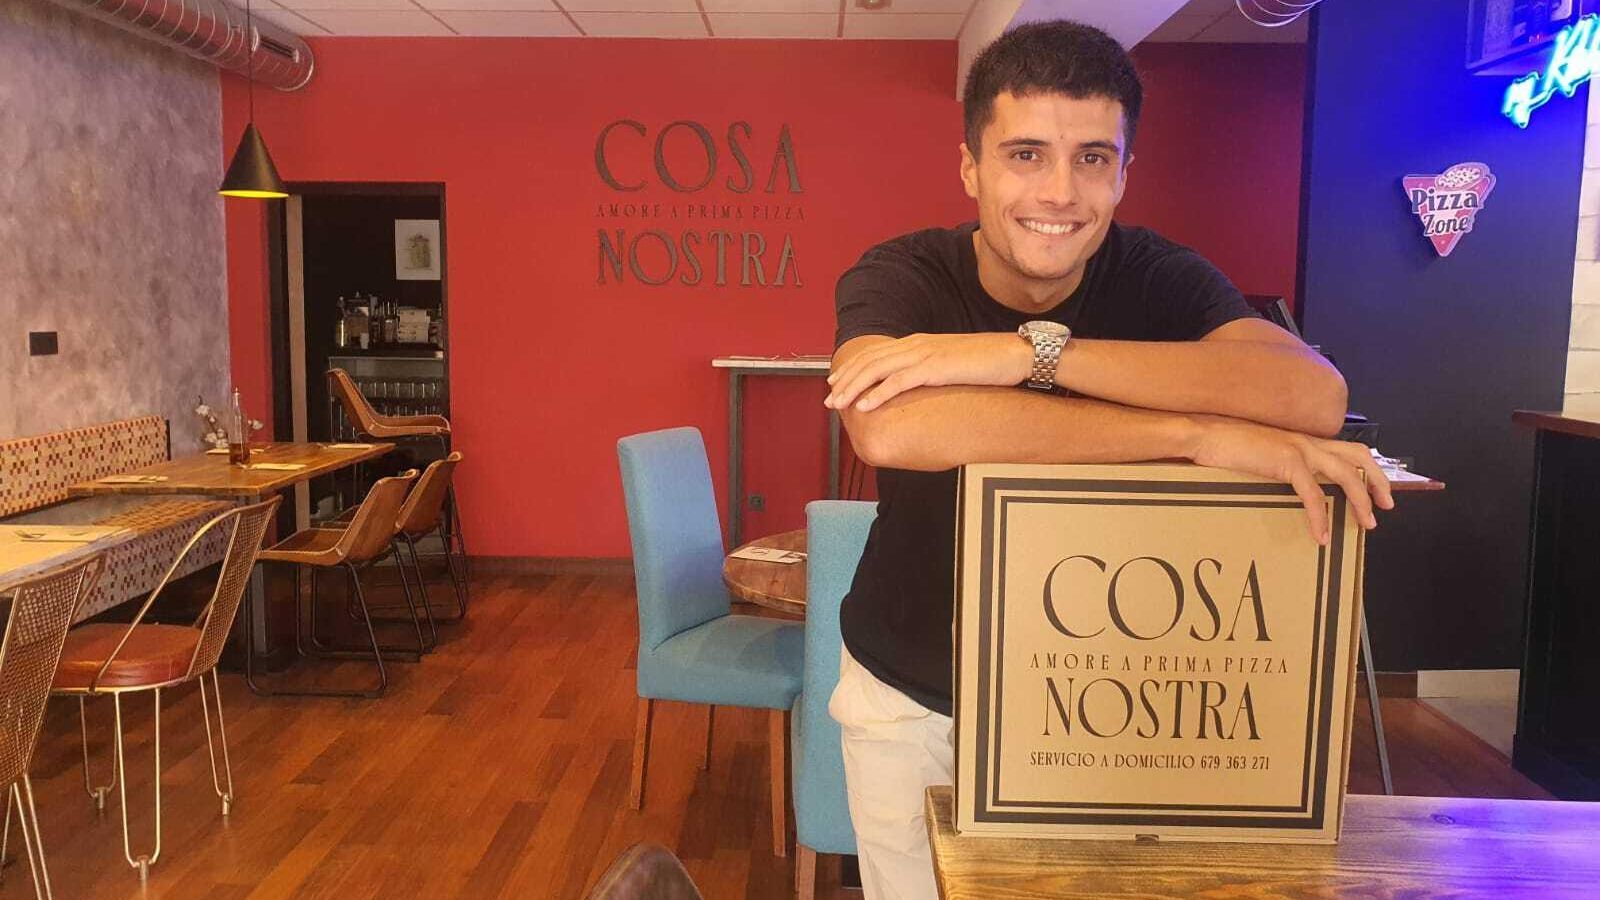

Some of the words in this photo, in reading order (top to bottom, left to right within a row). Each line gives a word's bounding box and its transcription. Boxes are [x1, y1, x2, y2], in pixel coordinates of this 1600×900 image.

[596, 119, 805, 194] COSA
[596, 203, 662, 220] AMORE
[670, 205, 679, 220] A
[687, 205, 745, 220] PRIMA
[752, 205, 808, 221] PIZZA
[1411, 188, 1479, 213] Pizza
[1423, 214, 1470, 235] Zone
[596, 228, 804, 288] NOSTRA
[1042, 554, 1273, 643] COSA
[1029, 652, 1111, 671] AMORE
[1121, 654, 1132, 672] A
[1143, 654, 1213, 674] PRIMA
[1224, 656, 1288, 675] PIZZA
[1041, 676, 1262, 741] NOSTRA
[1029, 751, 1096, 768] SERVICIO
[1100, 753, 1109, 768] A
[1113, 752, 1196, 770] DOMICILIO
[1200, 754, 1222, 771] 679
[1225, 754, 1248, 771] 363
[1251, 755, 1270, 772] 271
